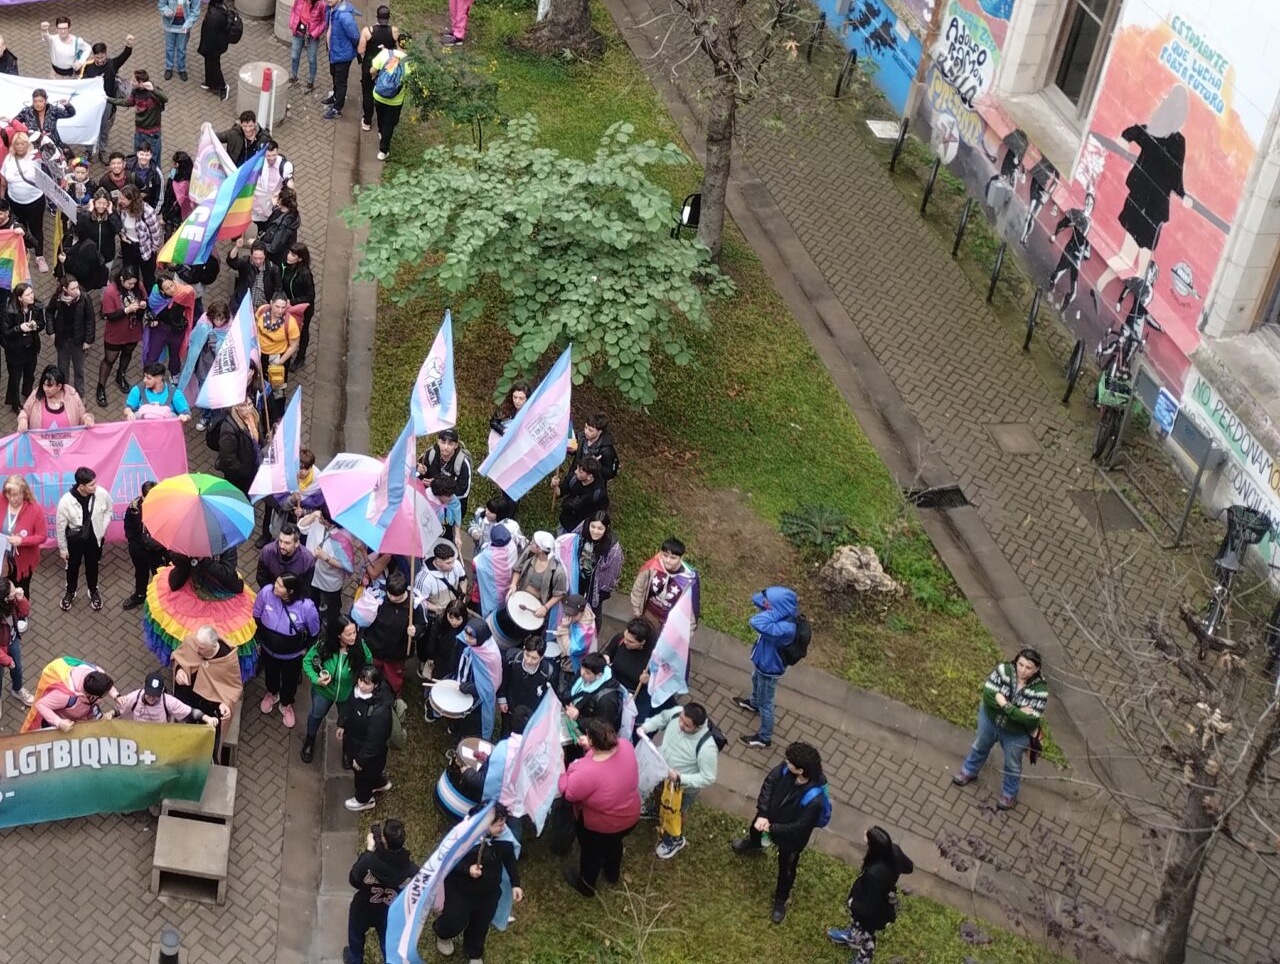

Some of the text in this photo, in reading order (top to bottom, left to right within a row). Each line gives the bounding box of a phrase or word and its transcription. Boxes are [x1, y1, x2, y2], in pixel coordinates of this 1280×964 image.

[1170, 15, 1229, 76] ESTUDIANTE
[1170, 40, 1190, 62] QUE
[4, 736, 157, 779] LGTBIQNB+
